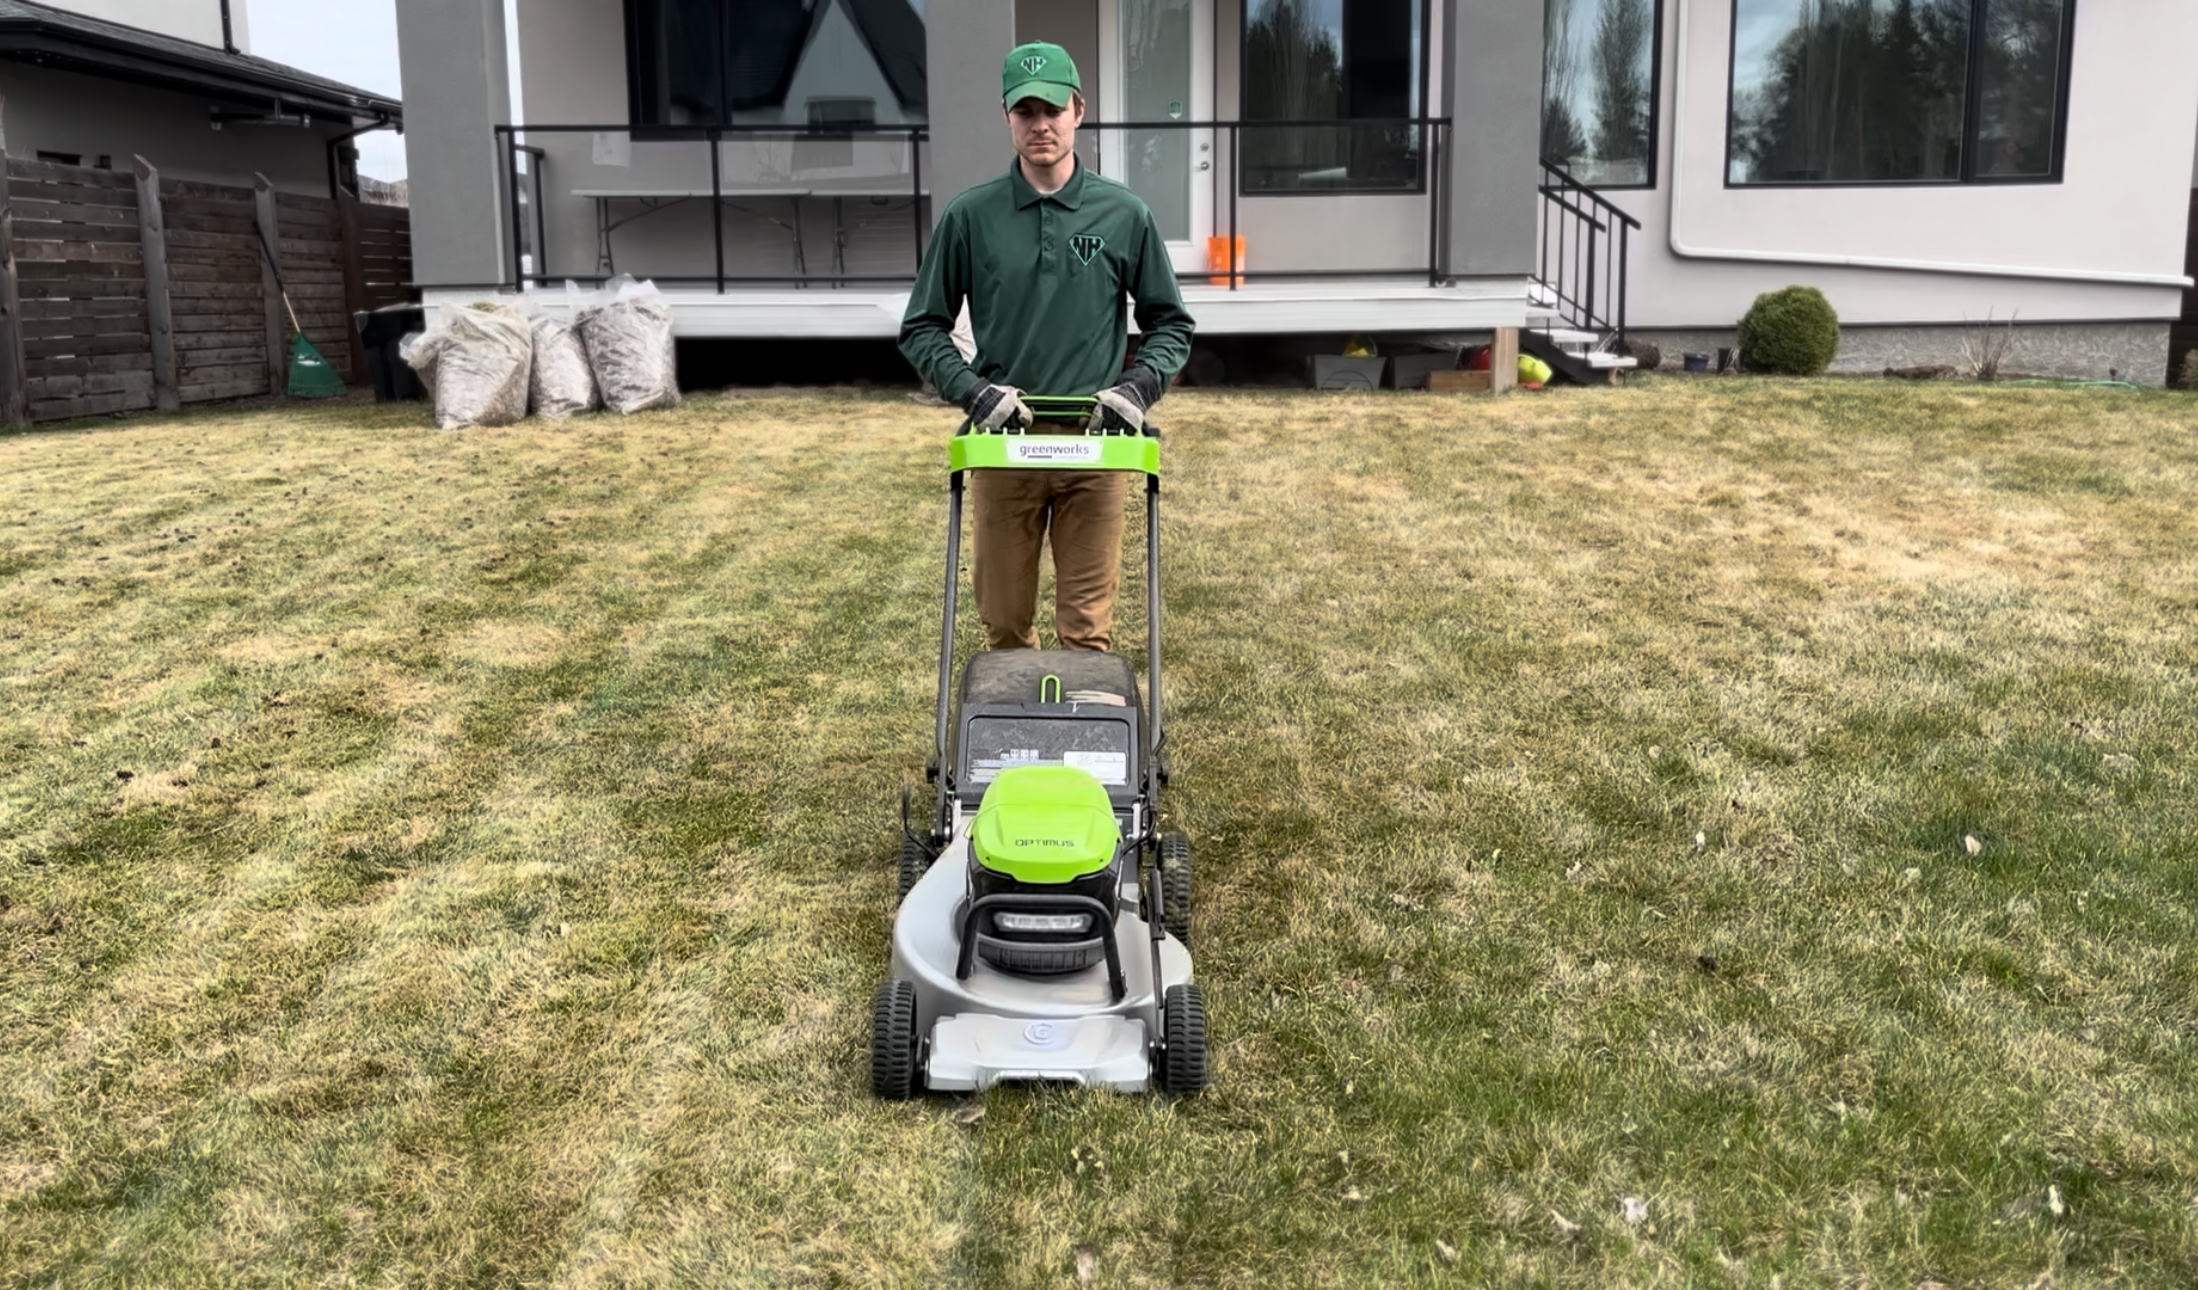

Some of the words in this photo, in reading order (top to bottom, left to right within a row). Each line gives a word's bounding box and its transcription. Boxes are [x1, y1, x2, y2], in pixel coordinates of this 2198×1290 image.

[1023, 57, 1043, 71] NH
[1073, 236, 1100, 261] NH
[1019, 442, 1089, 457] greenworks
[1015, 838, 1075, 848] OPTIMUS
